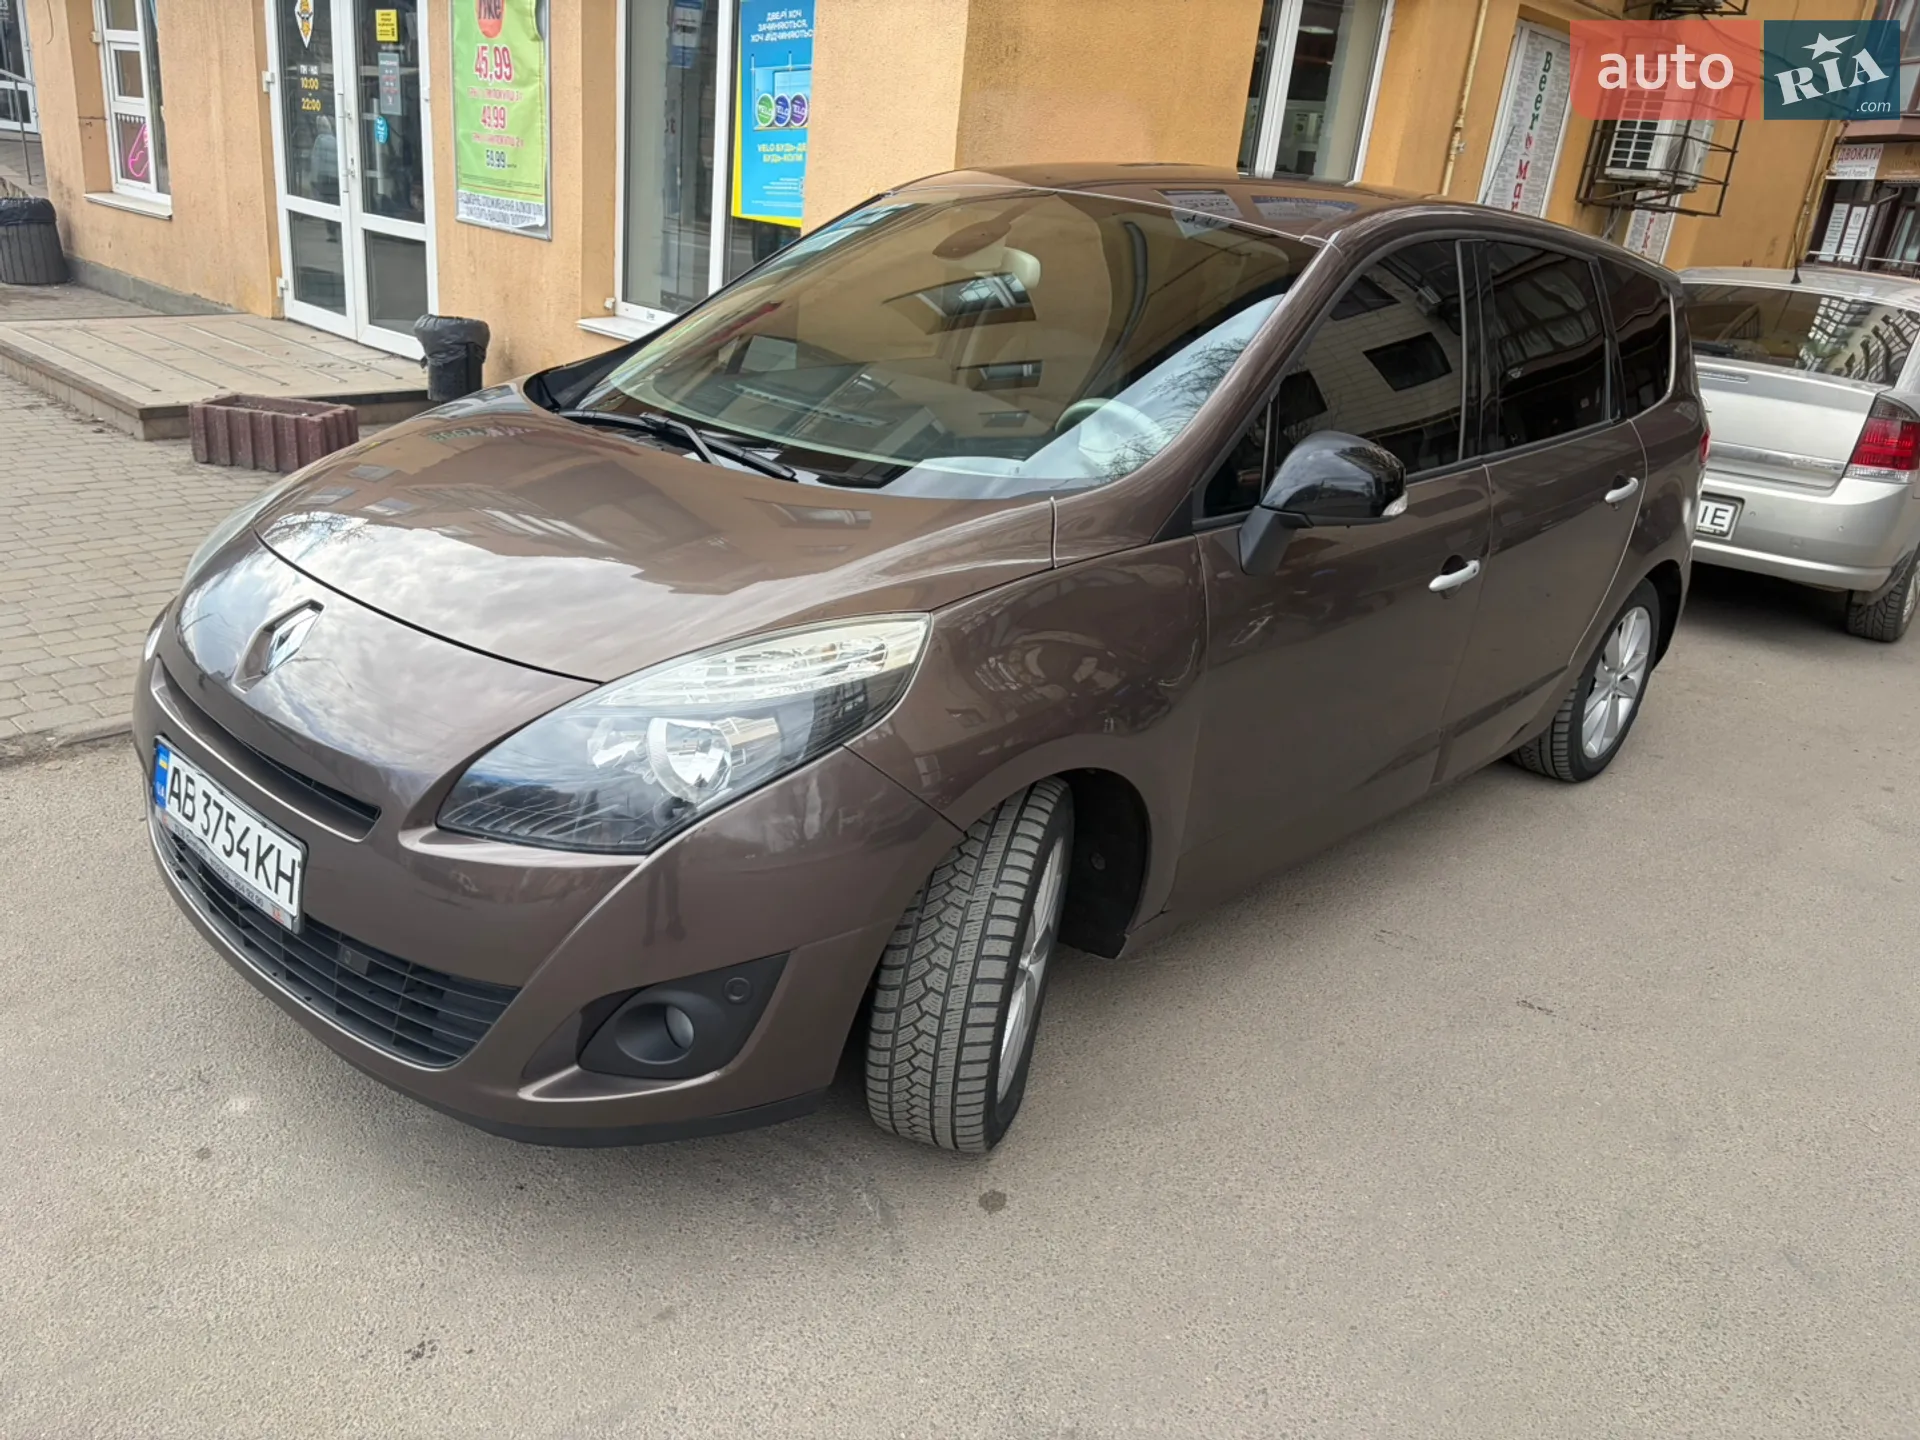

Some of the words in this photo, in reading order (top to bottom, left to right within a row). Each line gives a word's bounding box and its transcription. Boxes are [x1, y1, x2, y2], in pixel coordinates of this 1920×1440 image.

[764, 29, 814, 42] ВІДЧИНЯЮТЬС
[300, 77, 319, 90] 10:00
[1529, 51, 1553, 131] Beer
[301, 98, 322, 112] 22:00
